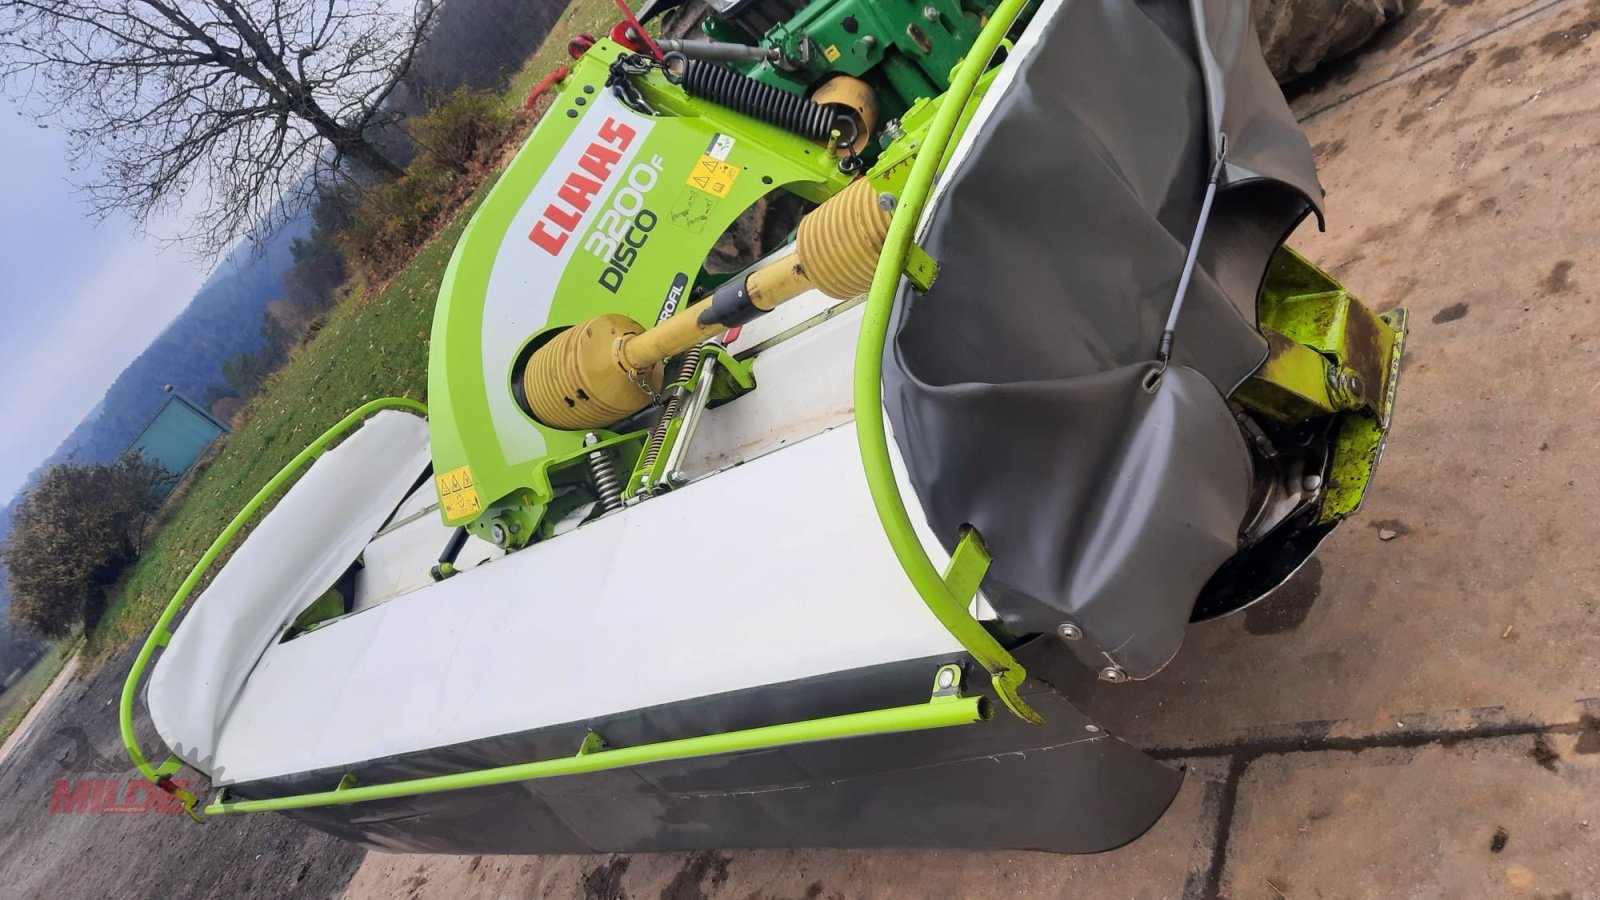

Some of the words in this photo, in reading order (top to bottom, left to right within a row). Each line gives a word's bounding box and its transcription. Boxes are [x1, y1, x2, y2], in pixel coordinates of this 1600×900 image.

[528, 116, 637, 257] CLAAS
[598, 209, 658, 294] DISCO
[657, 284, 684, 326] ROFIL
